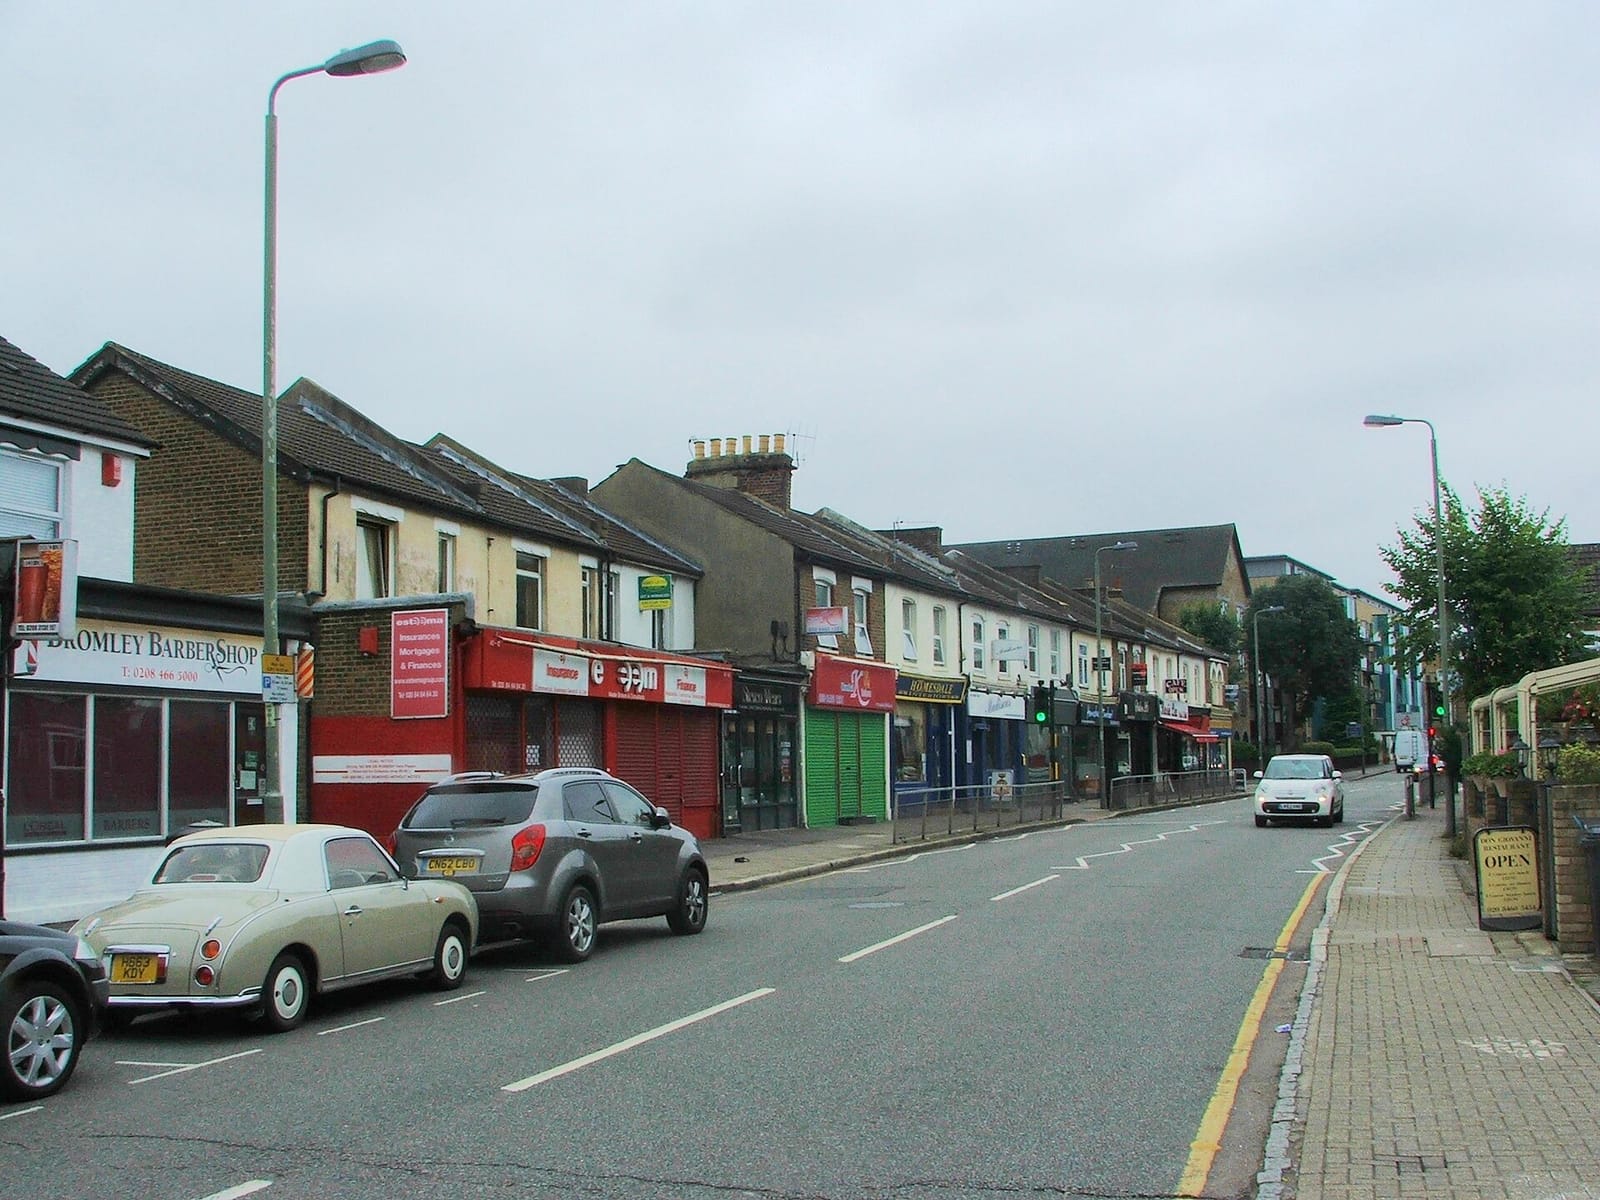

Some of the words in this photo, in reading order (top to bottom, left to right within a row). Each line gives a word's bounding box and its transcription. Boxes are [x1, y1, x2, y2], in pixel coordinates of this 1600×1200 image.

[399, 633, 440, 642] Insurances
[399, 647, 440, 656] Mortgages
[407, 661, 442, 669] Finances
[121, 666, 130, 677] T:
[133, 667, 156, 679] 0208
[159, 669, 174, 681] 466
[177, 670, 198, 682] 5000
[546, 663, 580, 681] Insurance
[677, 678, 697, 692] Finance
[911, 680, 953, 694] HOMESDALE
[1484, 844, 1529, 852] RESTAURANT
[429, 858, 453, 869] CN62
[1485, 854, 1530, 868] OPEN
[123, 968, 145, 979] KDY
